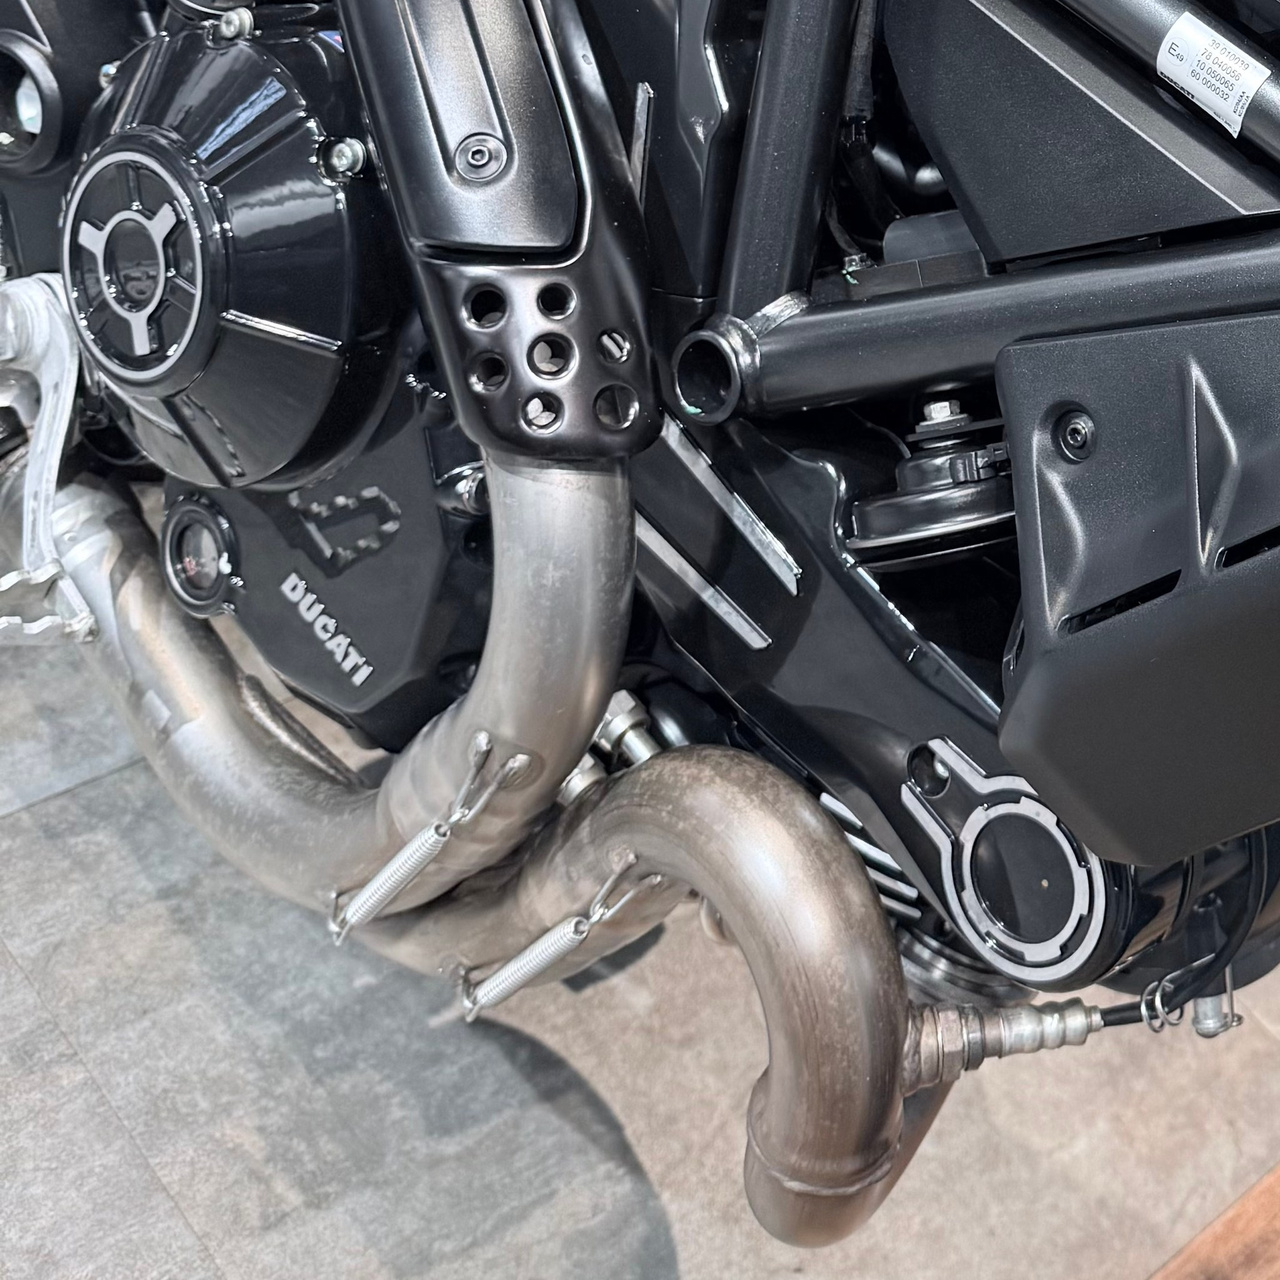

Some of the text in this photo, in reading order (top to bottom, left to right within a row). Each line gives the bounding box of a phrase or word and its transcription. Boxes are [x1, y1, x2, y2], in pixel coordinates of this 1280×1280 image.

[1195, 59, 1206, 71] 10
[1190, 68, 1201, 81] 60
[280, 572, 374, 687] DUCATI
